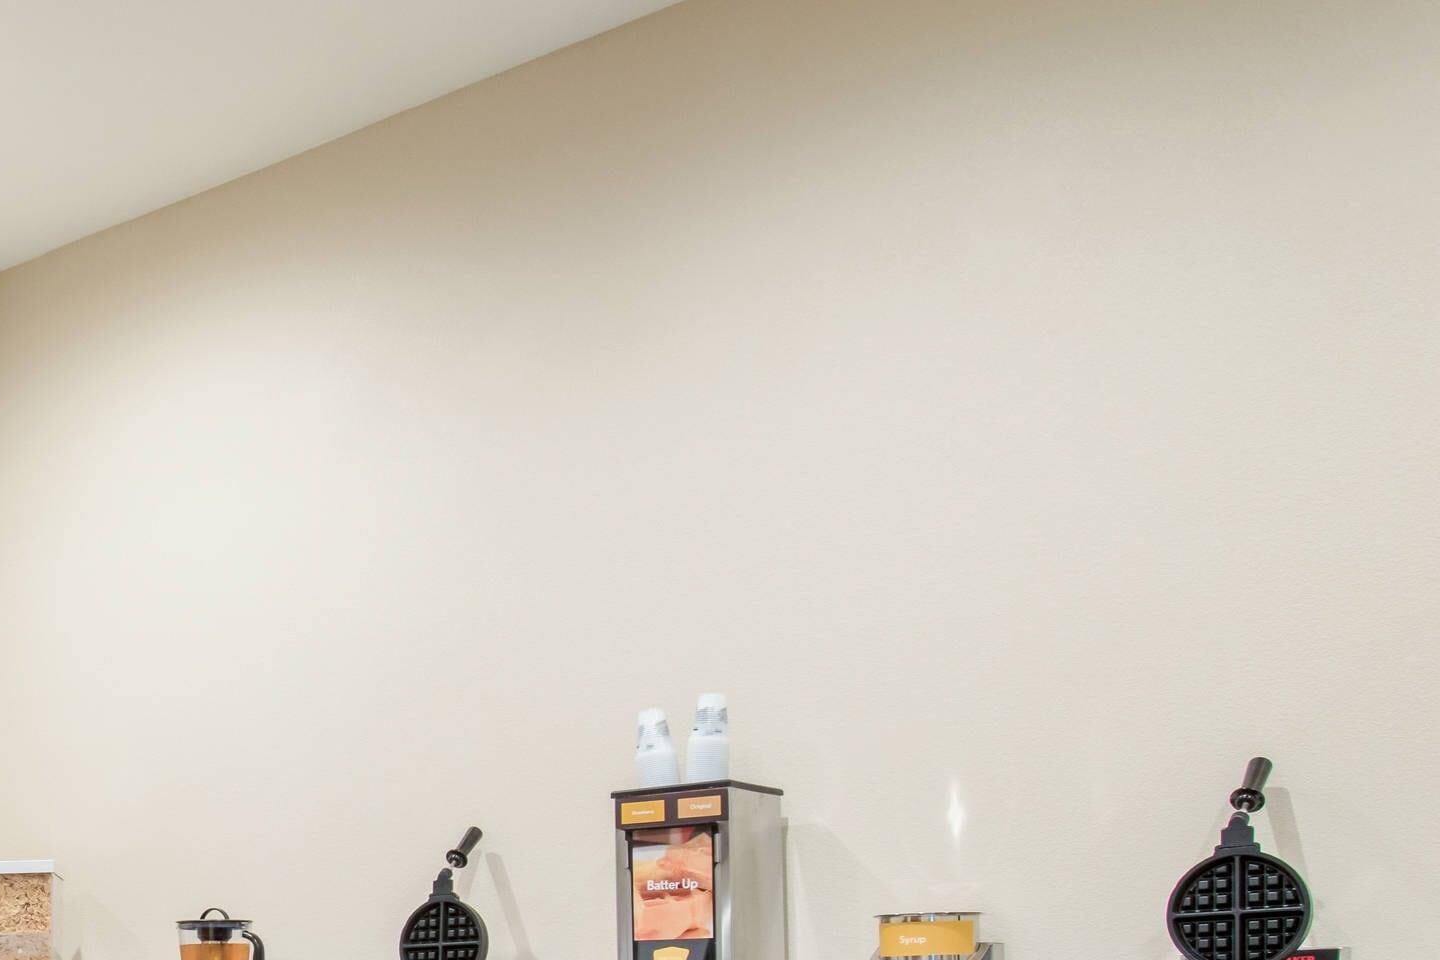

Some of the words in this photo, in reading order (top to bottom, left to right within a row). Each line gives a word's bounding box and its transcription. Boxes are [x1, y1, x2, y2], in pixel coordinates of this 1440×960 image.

[646, 879, 680, 891] Batter
[681, 878, 699, 890] Up
[899, 935, 927, 945] Syrup
